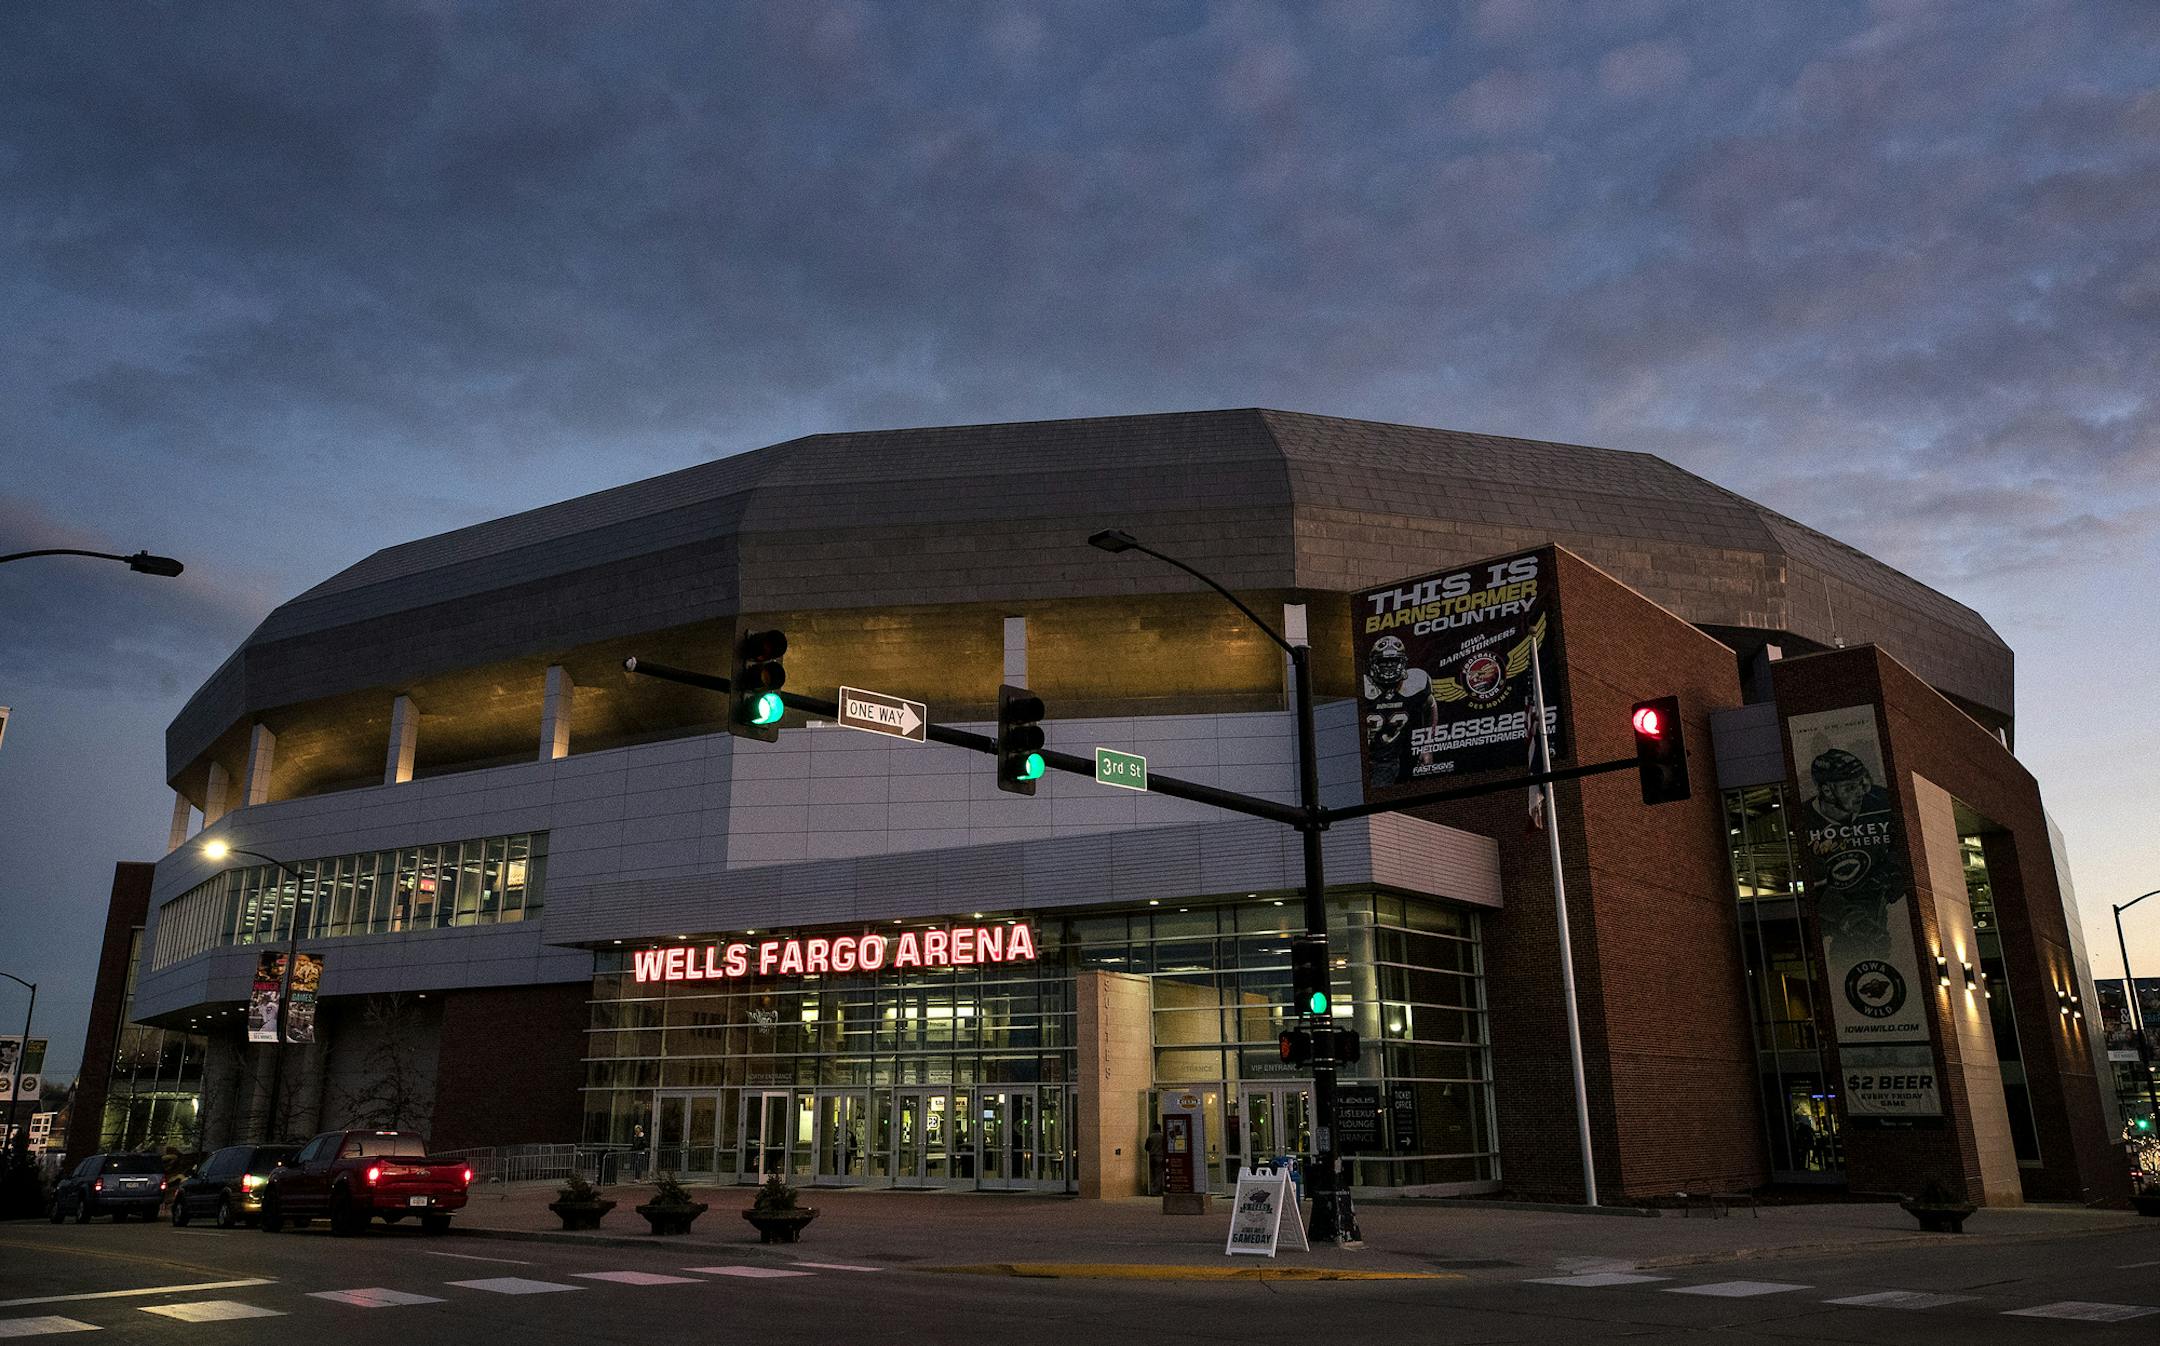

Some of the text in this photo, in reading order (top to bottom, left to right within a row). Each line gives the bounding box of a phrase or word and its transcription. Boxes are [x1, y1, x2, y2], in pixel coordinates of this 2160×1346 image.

[1368, 556, 1538, 615] THIS IS
[1365, 579, 1538, 634] BARNSTORMER
[1413, 596, 1537, 637] COUNTRY
[1439, 627, 1517, 667] BARNSTORMERS
[1460, 633, 1485, 650] IOWA
[1479, 687, 1500, 699] CLUB
[850, 701, 904, 725] ONE WAY
[1411, 705, 1557, 747] 515.633.225
[1103, 757, 1141, 778] 3rd St
[1809, 822, 1889, 841] HOCKEY
[1852, 834, 1891, 847] HERE
[634, 924, 1036, 982] WELLS FARGO ARENA
[1856, 962, 1886, 975] IOWA
[1864, 1005, 1893, 1017] WILD
[1844, 1023, 1919, 1034] IOWAWILD.COM
[1251, 1064, 1262, 1072] VIP
[1848, 1075, 1933, 1091] $2 BEER
[1232, 1233, 1272, 1244] GAMEDAY
